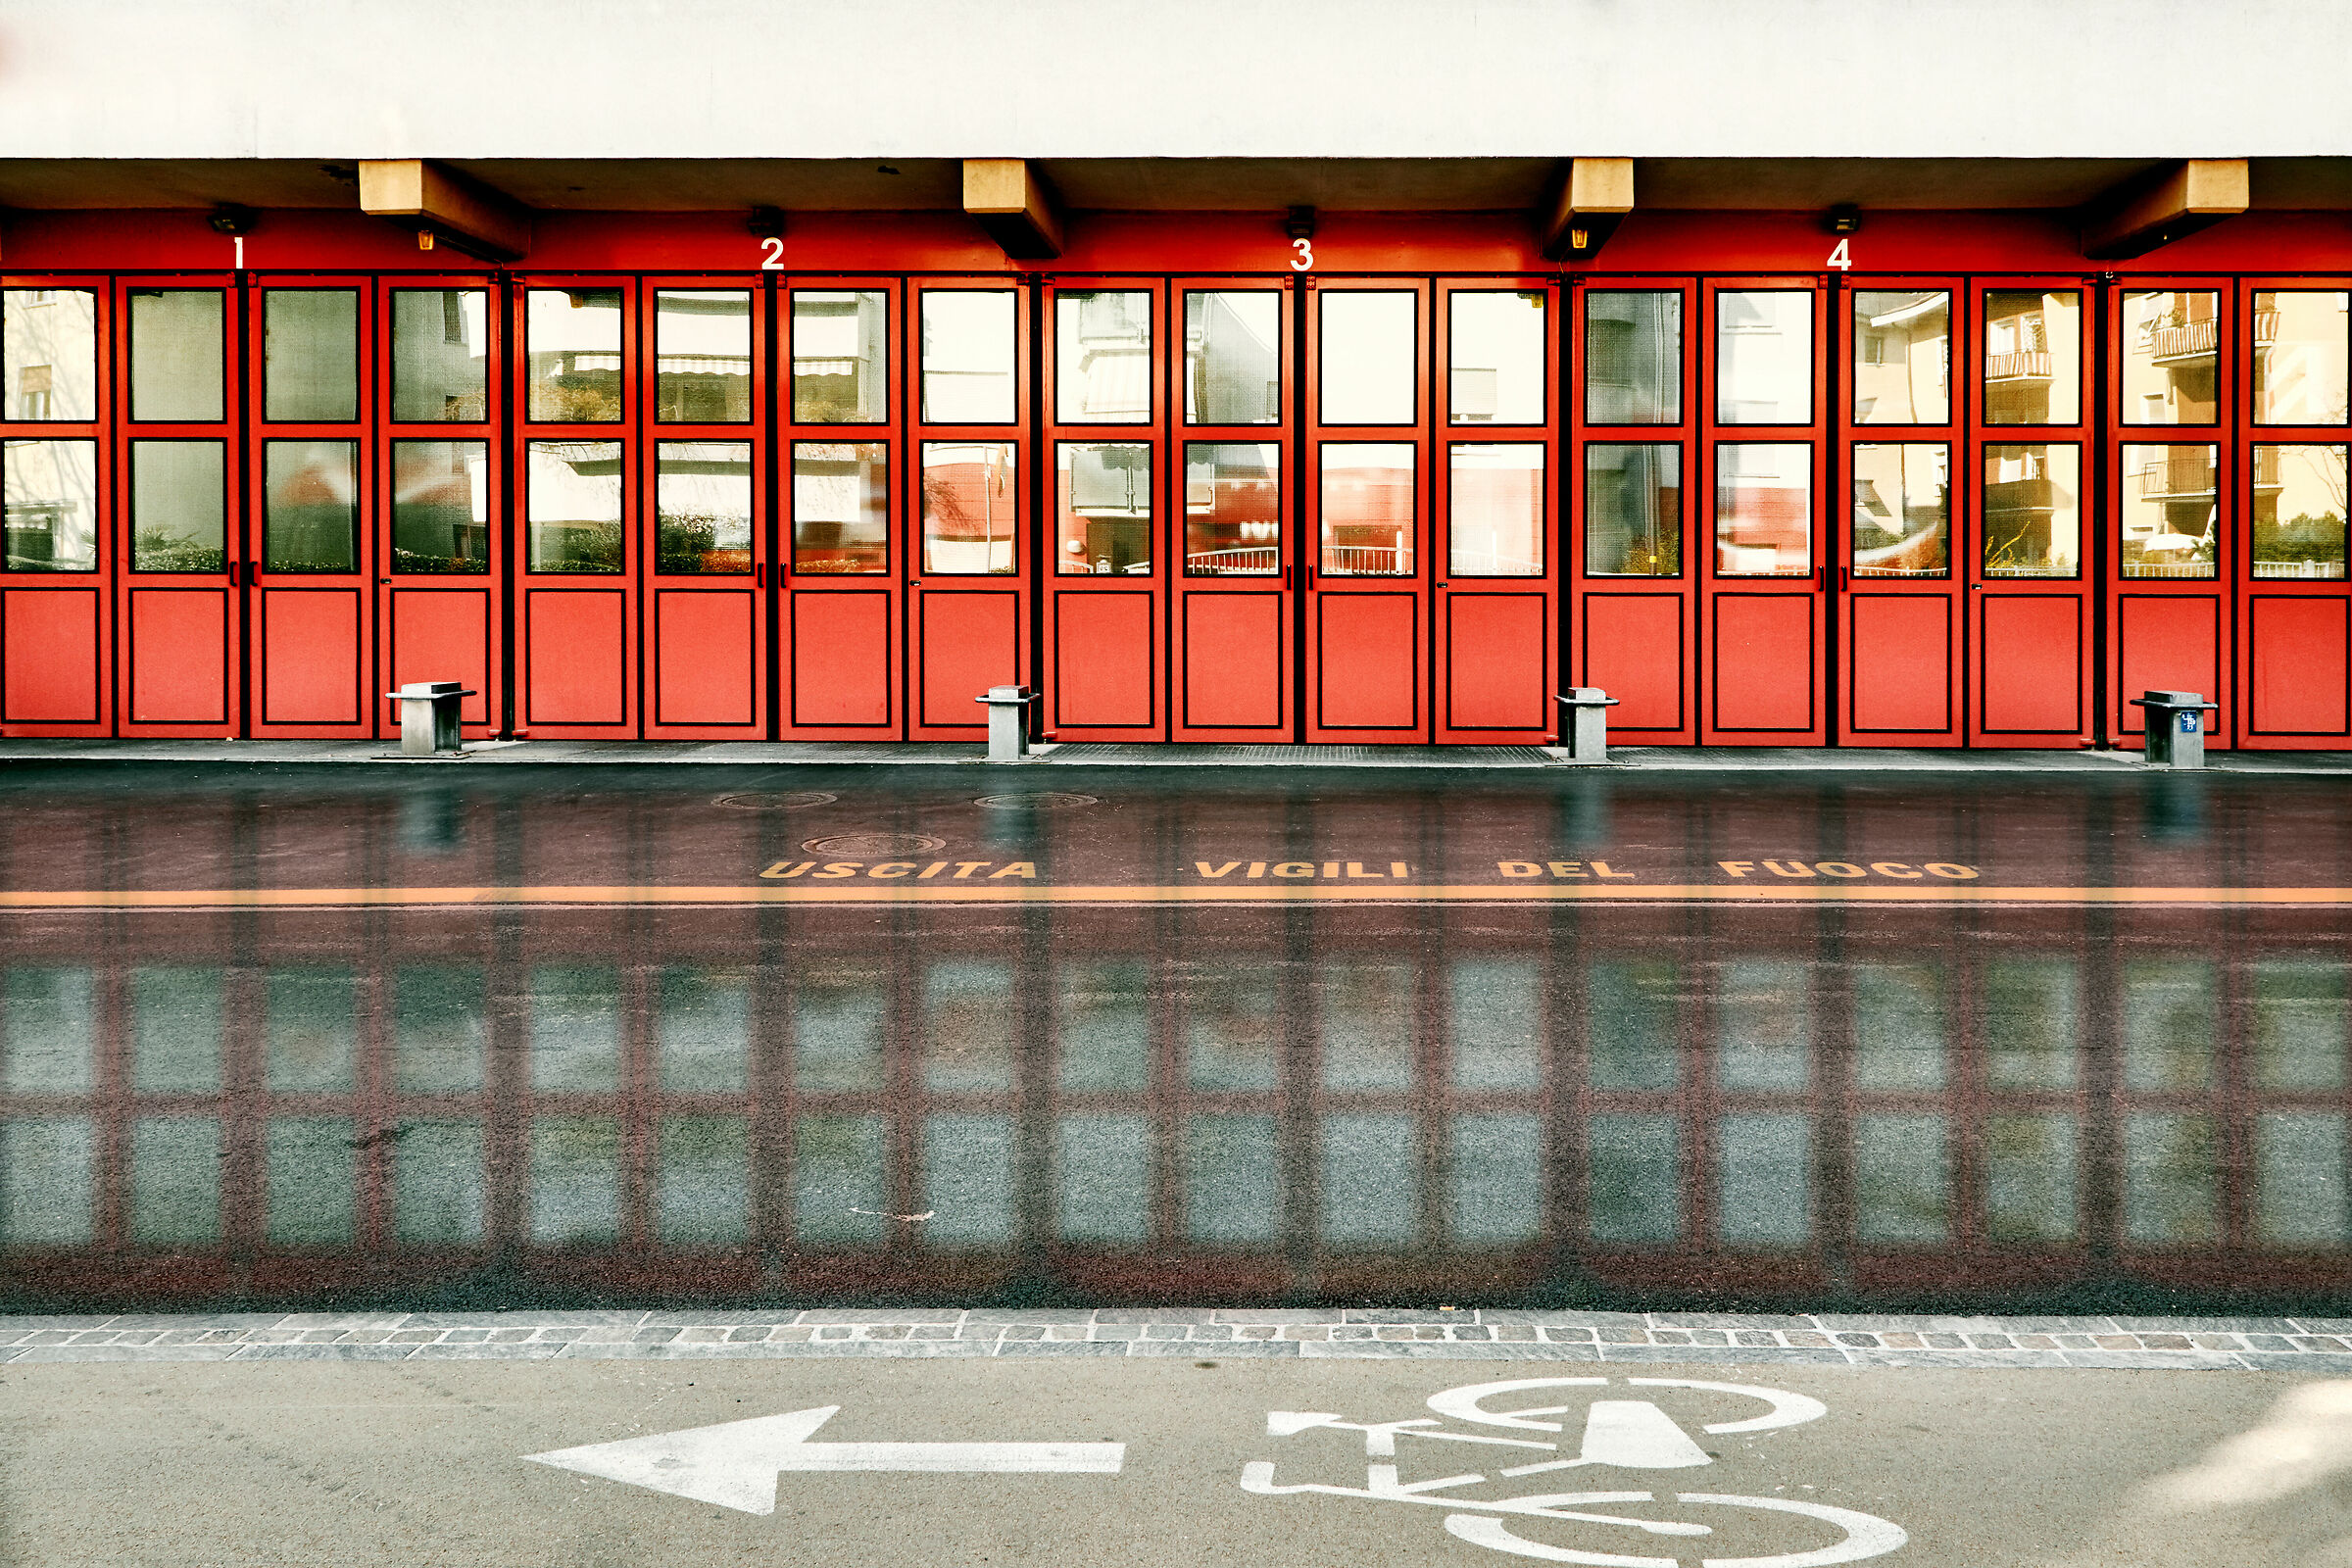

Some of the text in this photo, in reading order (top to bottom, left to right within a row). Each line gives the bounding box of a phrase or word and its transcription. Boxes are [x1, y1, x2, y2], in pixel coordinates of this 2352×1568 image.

[234, 237, 243, 270] 1
[760, 238, 784, 270] 2
[1290, 238, 1313, 270] 3
[1826, 238, 1851, 270] 4
[759, 861, 1980, 878] USCITA VIGILI DEL FUOCO
